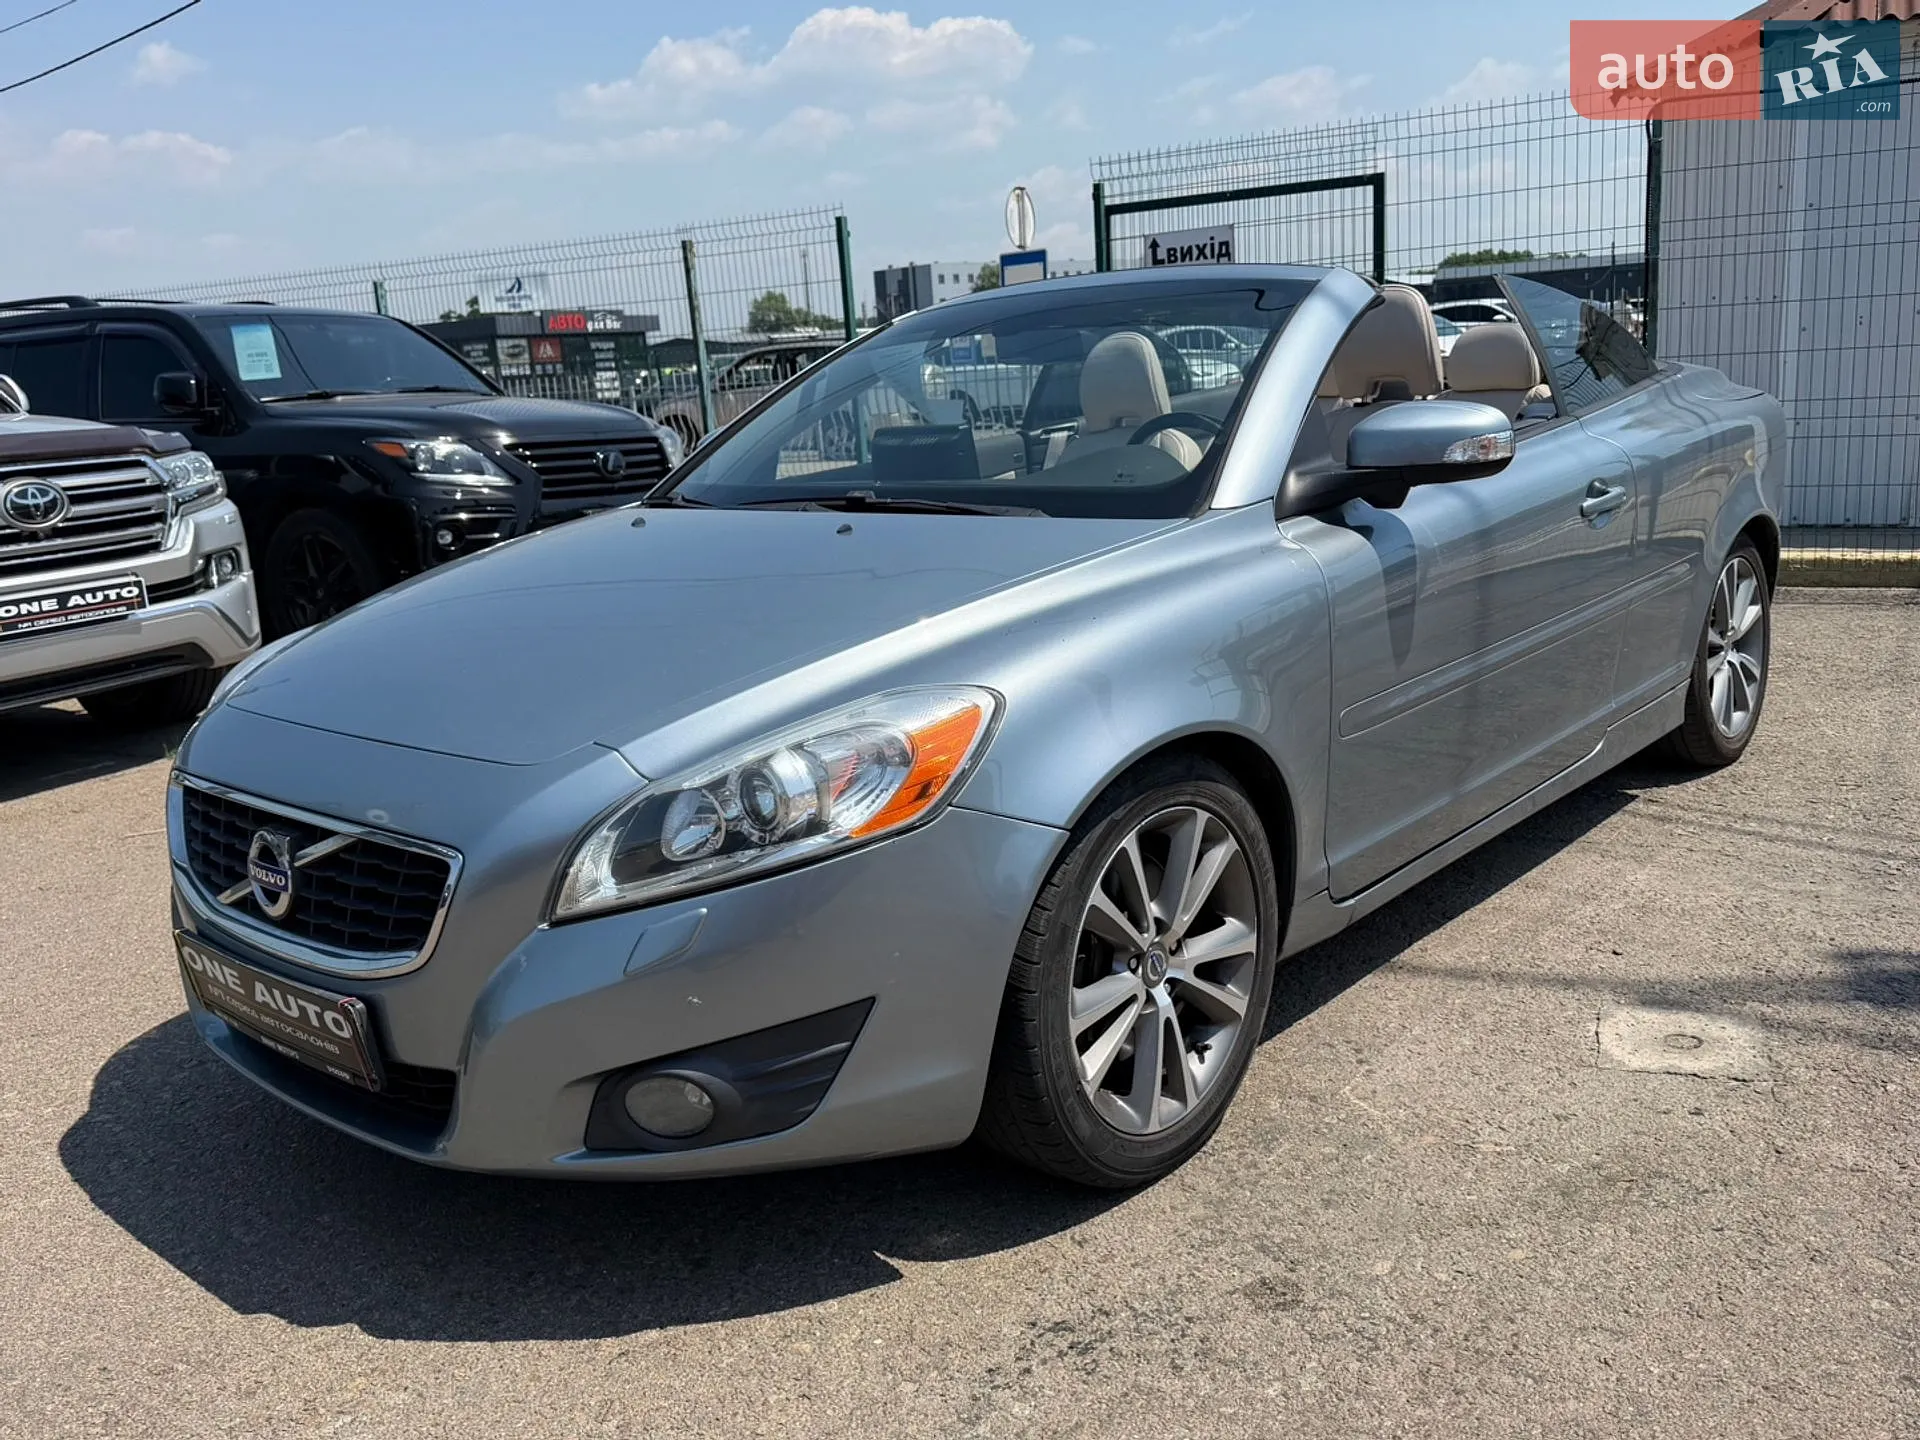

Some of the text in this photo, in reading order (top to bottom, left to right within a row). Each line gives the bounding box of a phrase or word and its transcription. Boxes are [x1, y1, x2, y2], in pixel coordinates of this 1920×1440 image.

[1167, 236, 1232, 264] вихід
[548, 311, 586, 330] АВТО
[0, 586, 140, 618] ONE AUTO
[249, 863, 286, 886] VOLVO
[181, 946, 353, 1039] ONE AUTO
